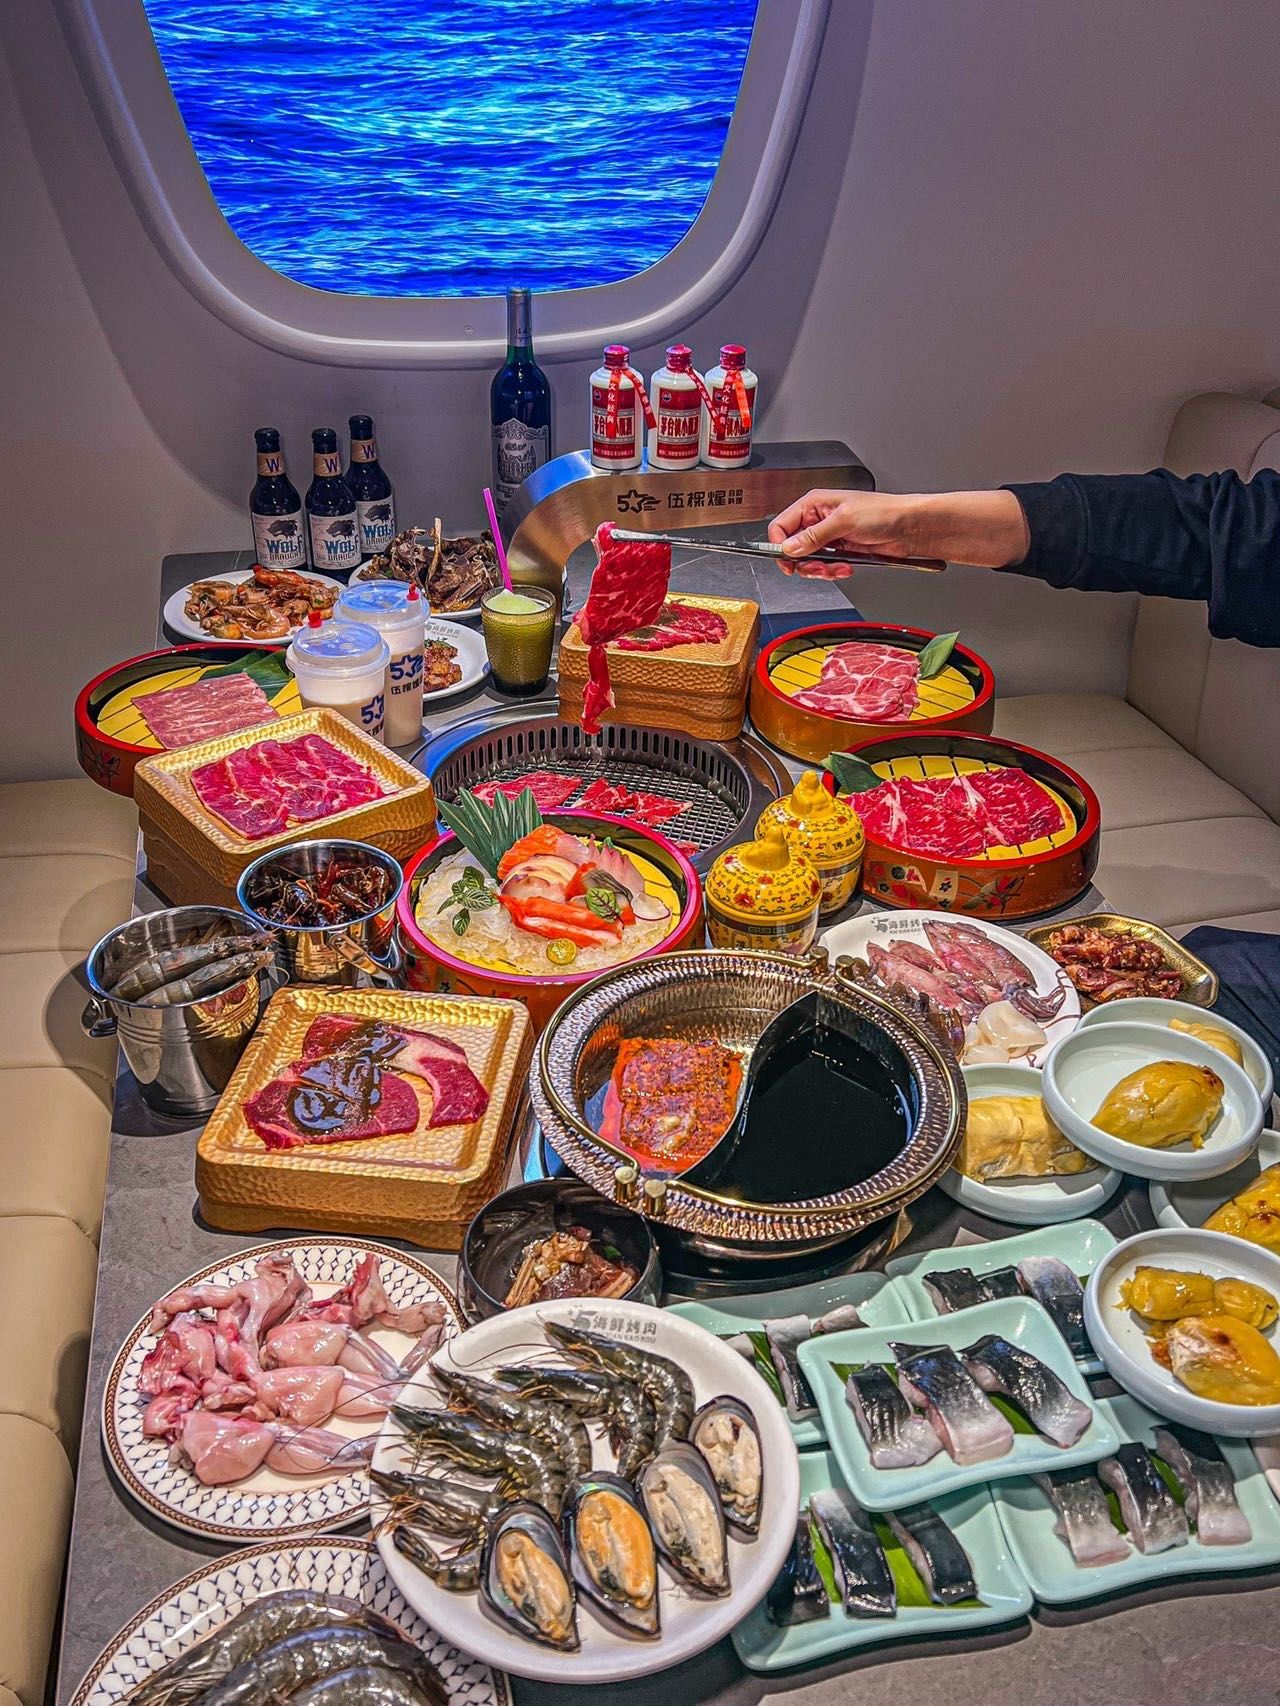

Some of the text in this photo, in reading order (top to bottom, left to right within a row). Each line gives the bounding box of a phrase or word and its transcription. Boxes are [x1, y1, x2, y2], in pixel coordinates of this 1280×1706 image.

[361, 443, 375, 460] W
[265, 457, 280, 473] W
[325, 457, 338, 473] W
